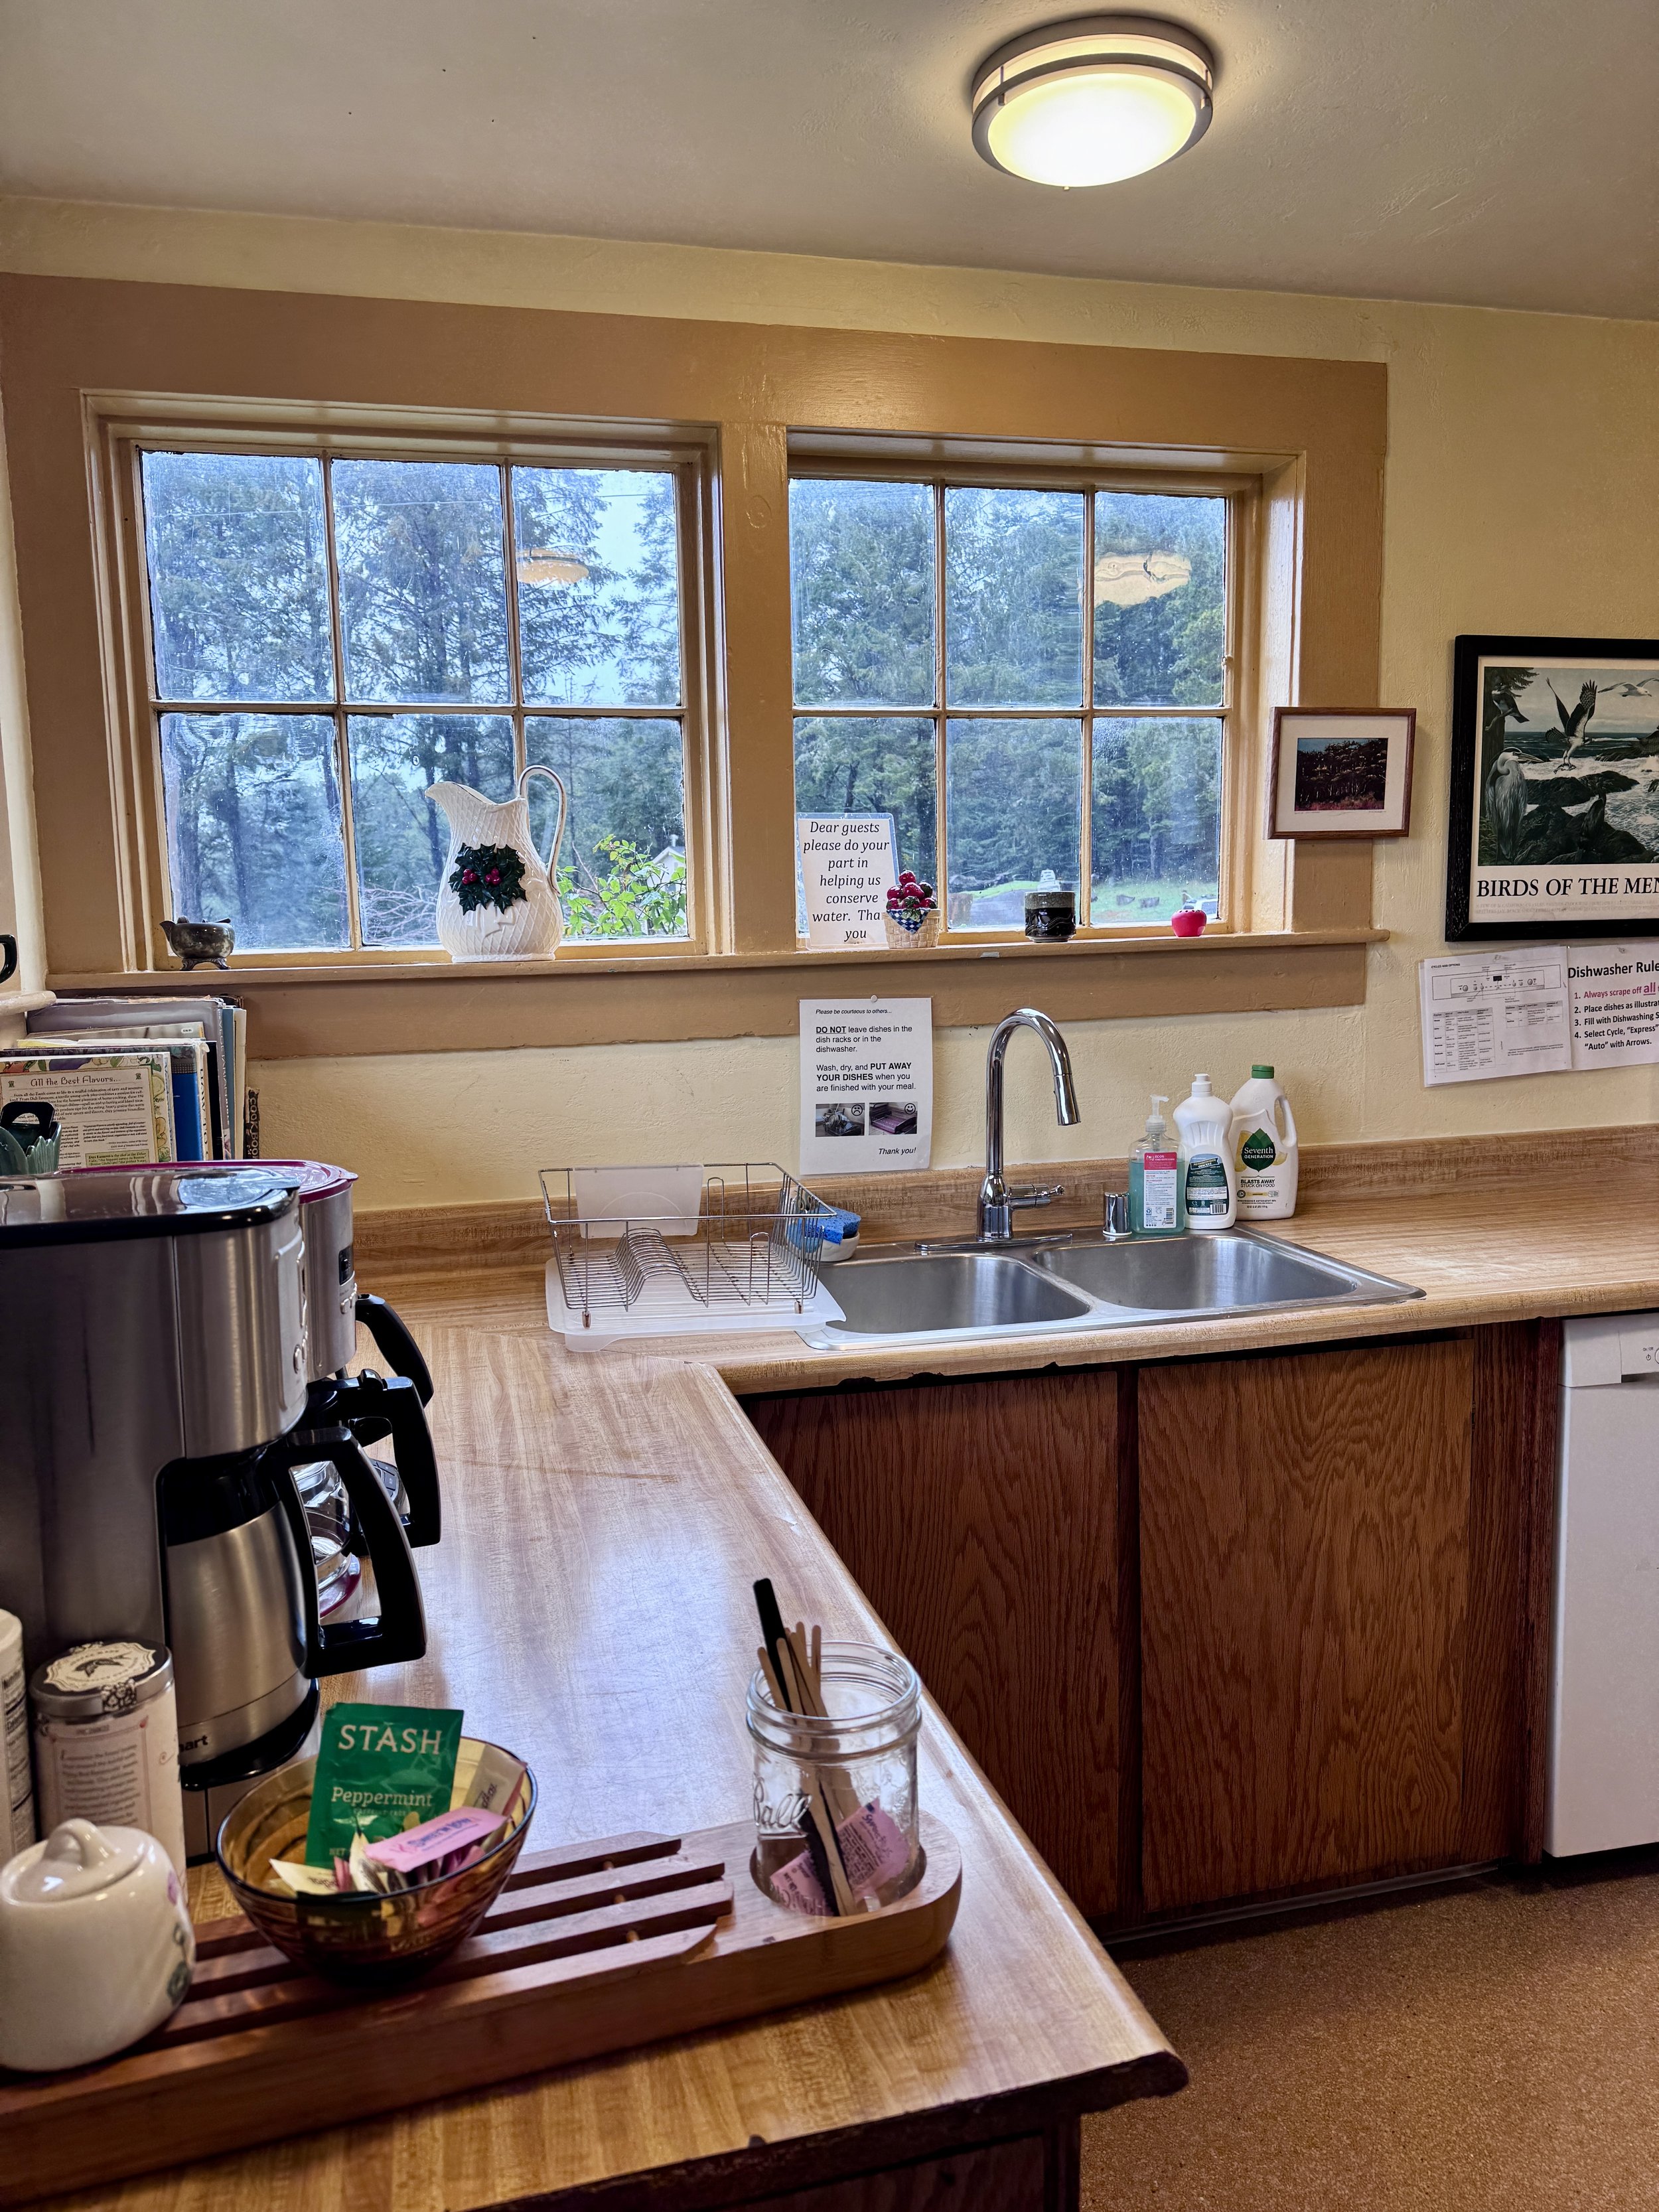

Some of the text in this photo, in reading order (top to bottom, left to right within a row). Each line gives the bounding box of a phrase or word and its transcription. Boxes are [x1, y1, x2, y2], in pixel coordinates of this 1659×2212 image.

[810, 822, 879, 836] Dear guests
[804, 840, 889, 853] please do your
[828, 857, 868, 871] part in
[820, 875, 881, 889] helping us
[1477, 879, 1538, 897] BIRDS
[1546, 879, 1573, 896] OF
[1579, 877, 1619, 895] THE
[826, 894, 878, 904] conserve
[813, 909, 880, 922] water. Tha
[844, 930, 867, 941] you
[1568, 964, 1632, 978] Dishwasher
[1644, 982, 1656, 994] all
[1613, 1013, 1654, 1023] Dishwashing
[1607, 1028, 1625, 1037] Cycle,
[61, 1076, 80, 1084] Best
[901, 1147, 916, 1155] you!
[338, 1724, 443, 1755] STASH
[331, 1787, 433, 1806] Peppermint
[753, 1773, 812, 1829] Ball
